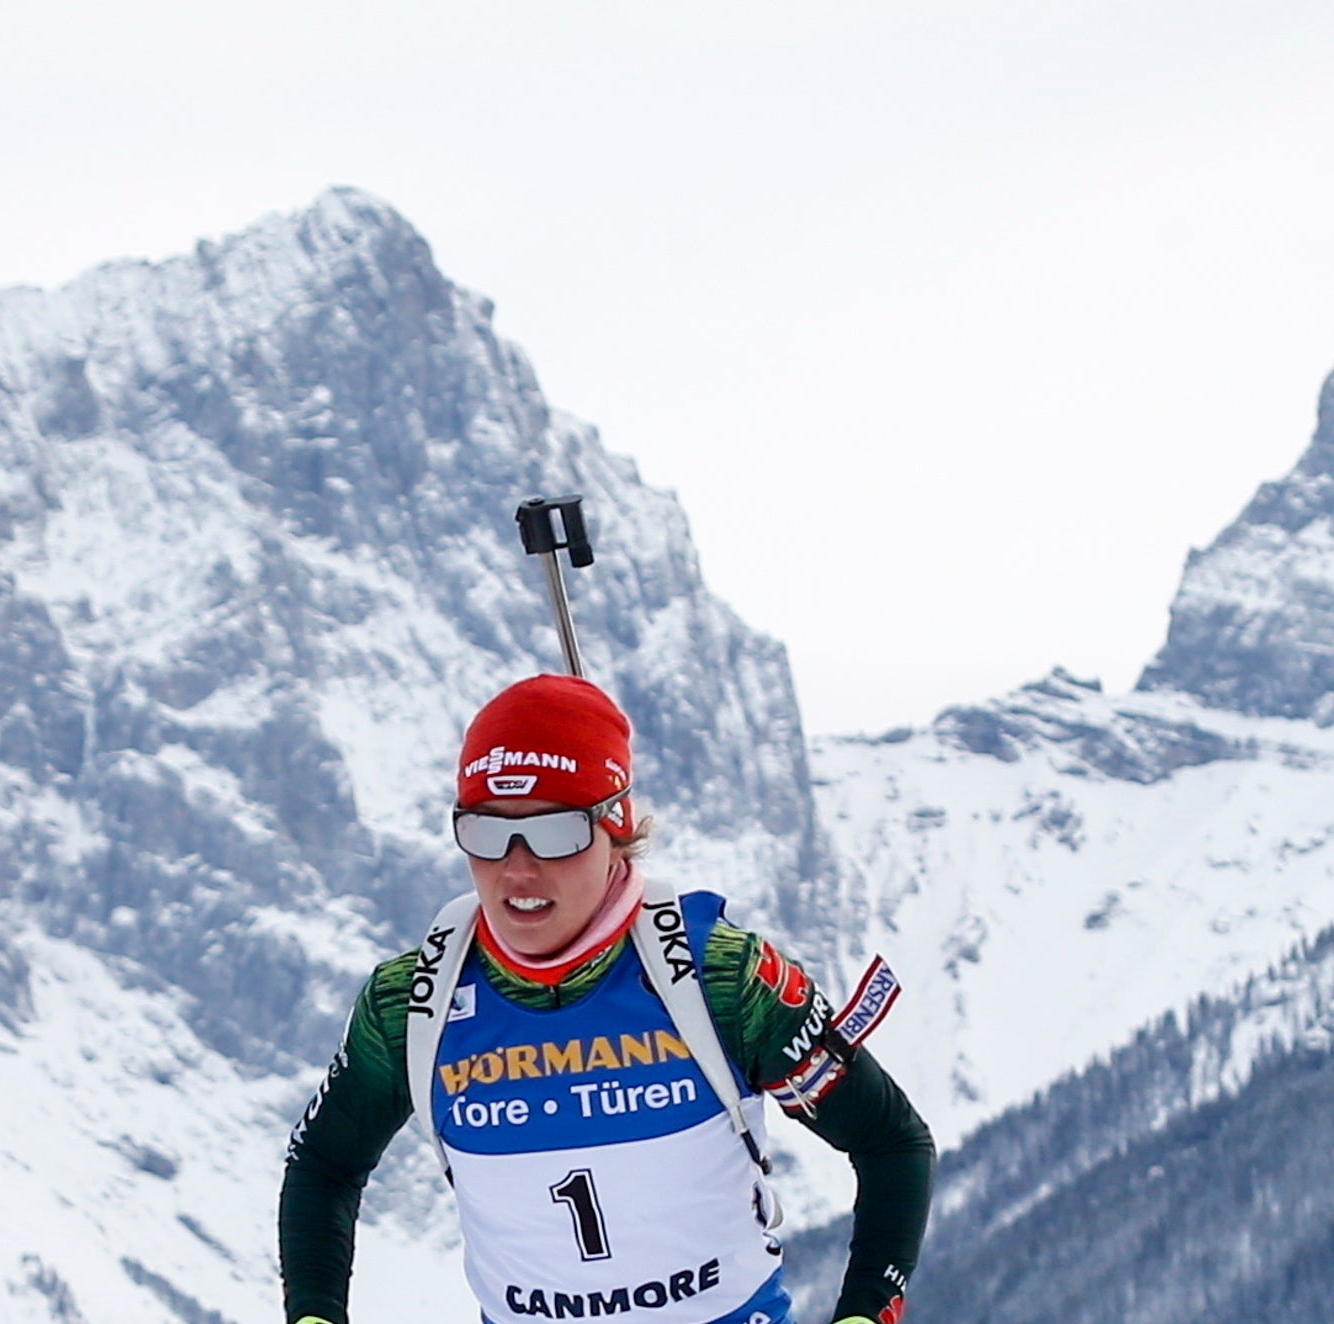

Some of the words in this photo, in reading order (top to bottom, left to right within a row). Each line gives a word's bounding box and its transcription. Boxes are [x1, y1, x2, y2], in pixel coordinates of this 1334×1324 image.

[464, 746, 577, 777] VIESSMANN
[408, 927, 456, 1018] JOKA
[642, 901, 695, 985] JOKA
[438, 1029, 691, 1096] HÖRMANN
[570, 1076, 697, 1118] Türen
[549, 1168, 612, 1262] 1
[506, 1257, 720, 1319] CANMORE
